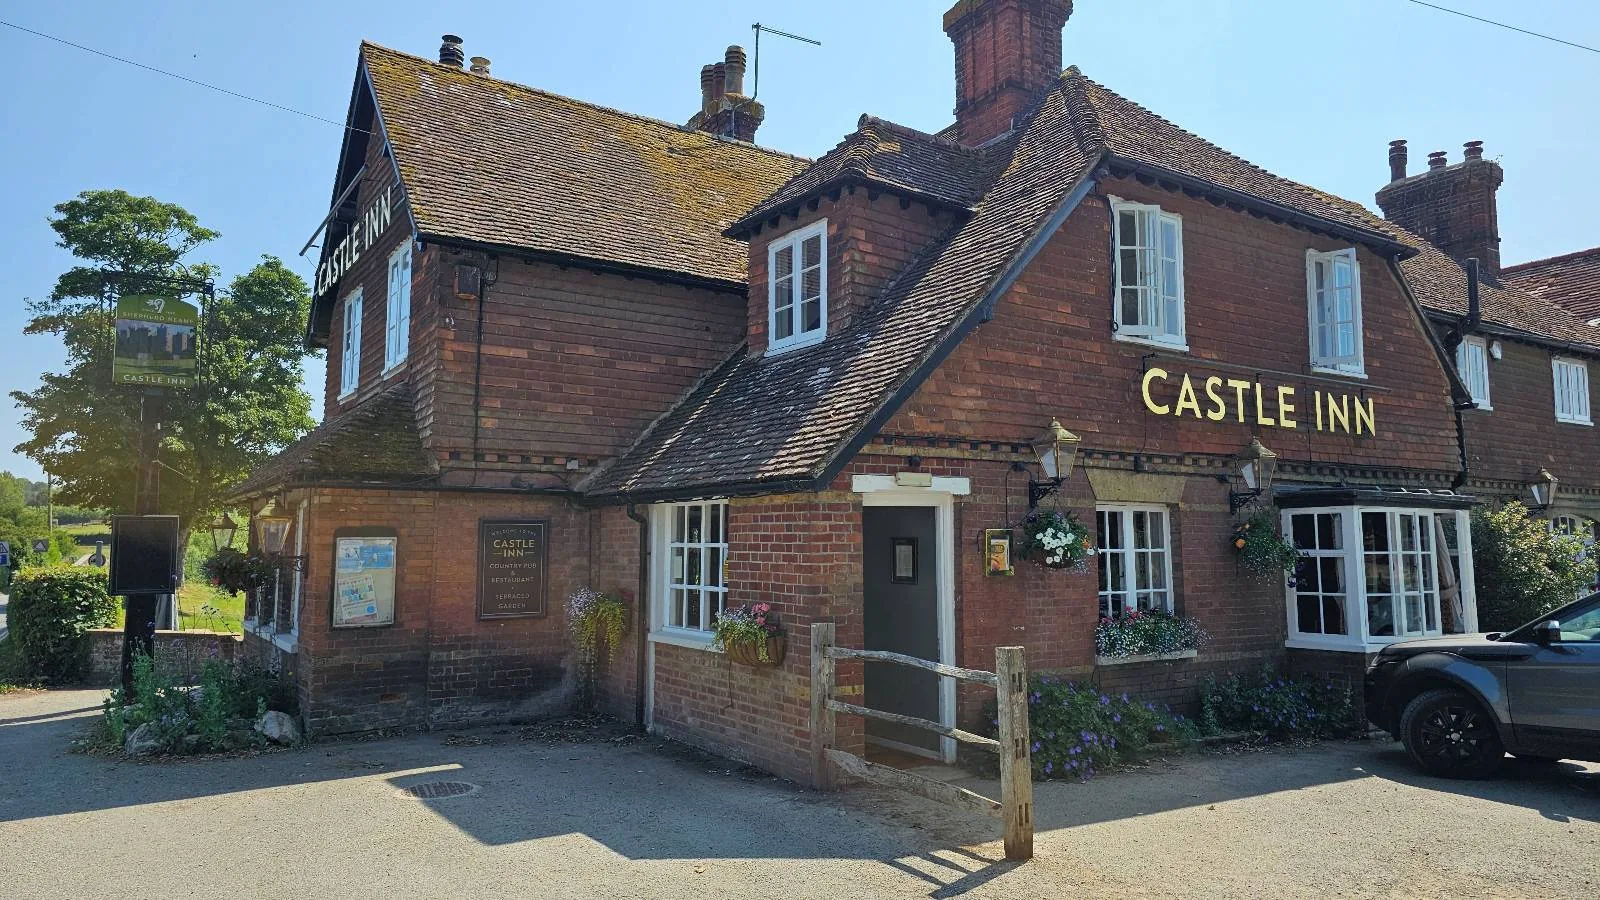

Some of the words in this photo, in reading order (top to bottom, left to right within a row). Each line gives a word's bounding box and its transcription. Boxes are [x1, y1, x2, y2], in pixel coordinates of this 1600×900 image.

[319, 222, 360, 297] CASTLE
[365, 185, 391, 251] INN
[123, 375, 162, 383] CASTLE
[167, 377, 186, 385] INN
[1142, 367, 1297, 429] CASTLE
[1315, 390, 1376, 437] INN
[493, 539, 535, 548] CASTLE
[503, 549, 524, 558] INN
